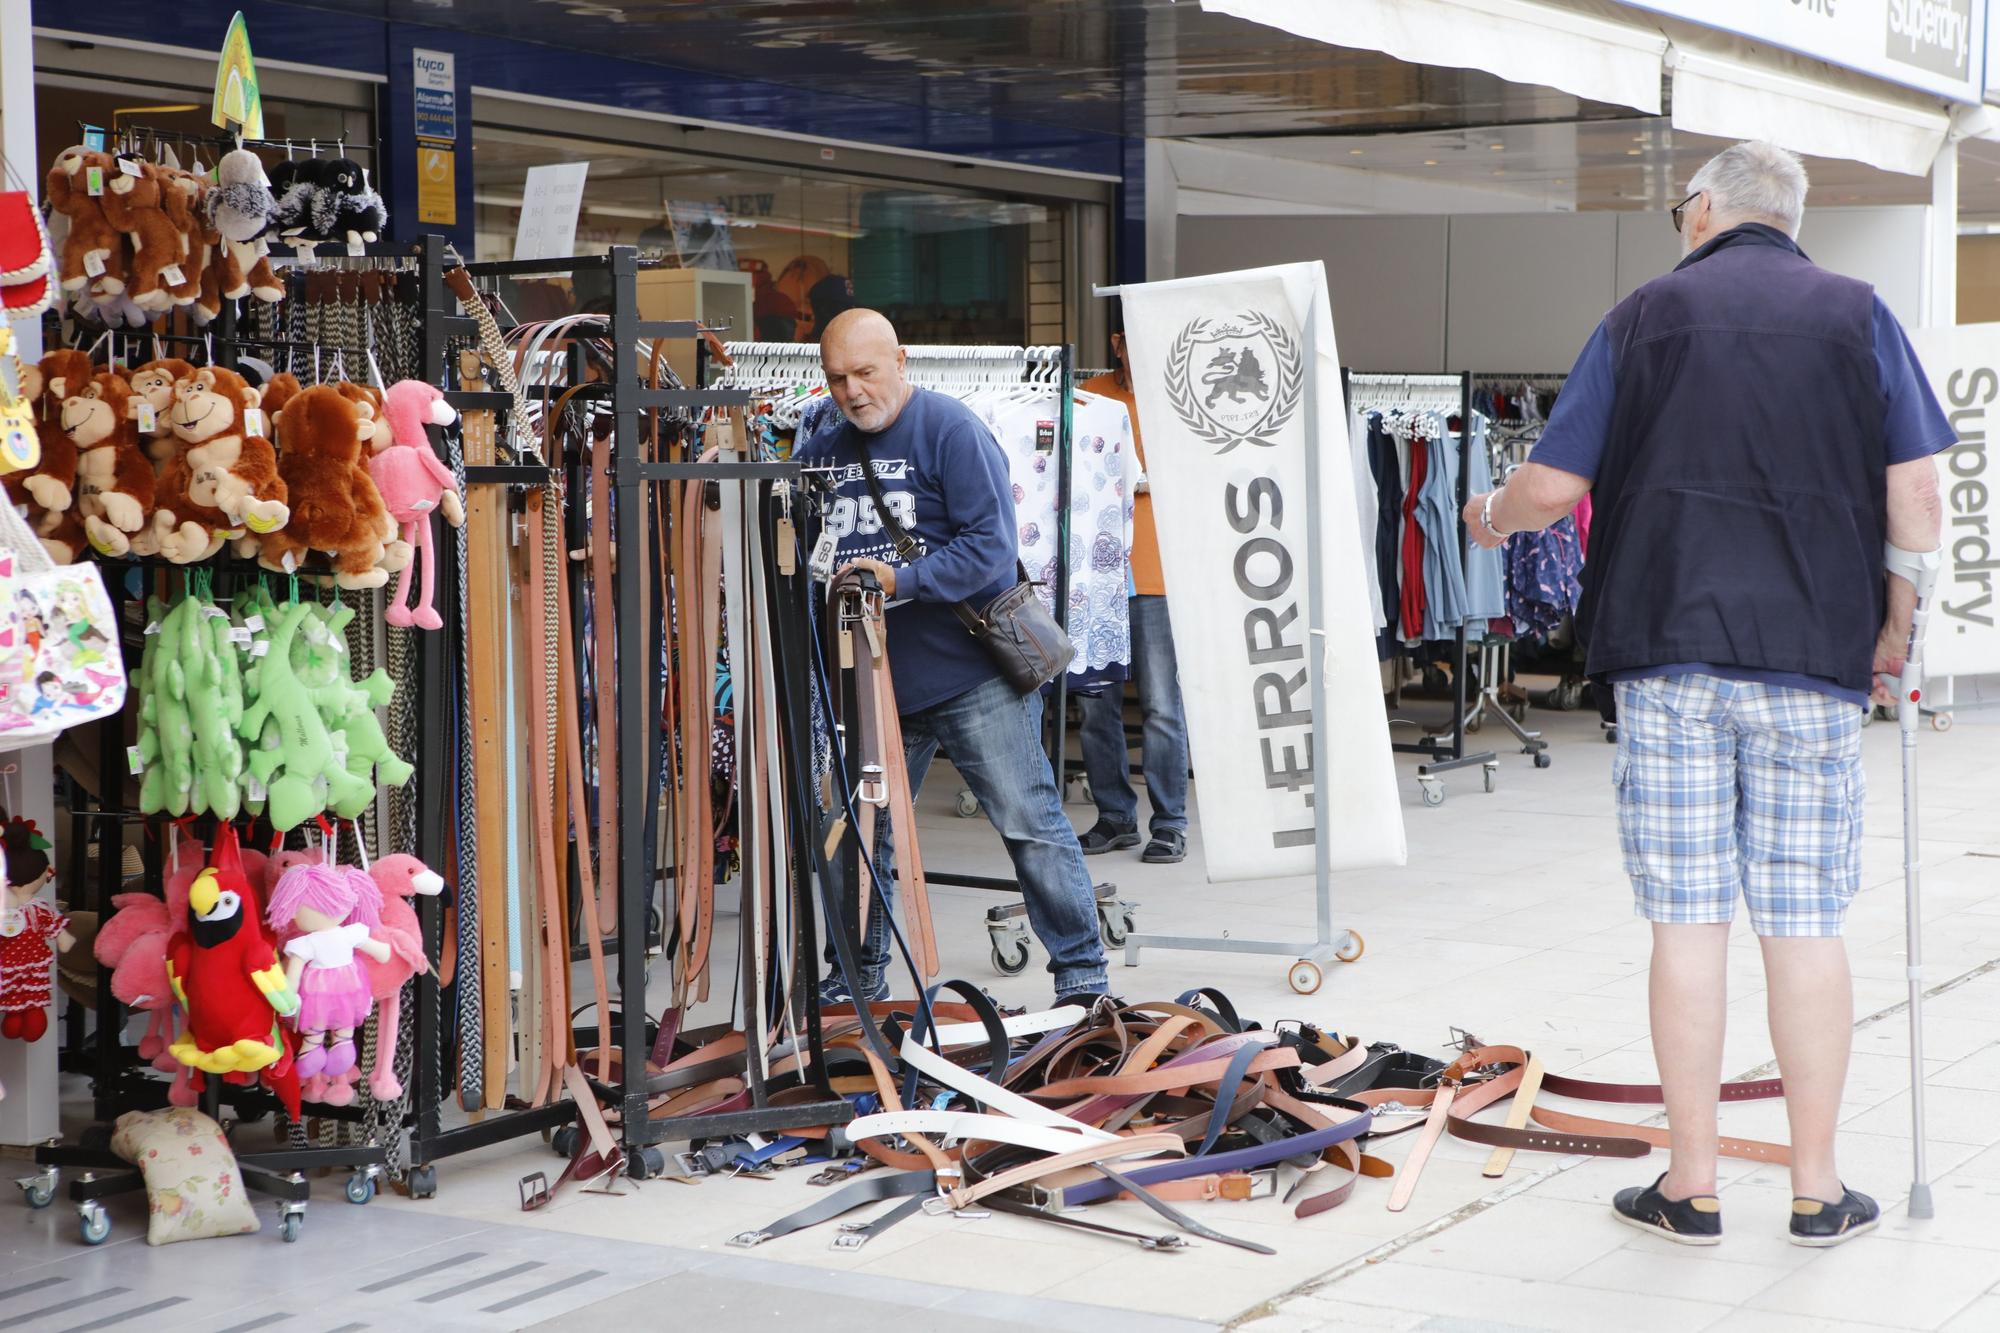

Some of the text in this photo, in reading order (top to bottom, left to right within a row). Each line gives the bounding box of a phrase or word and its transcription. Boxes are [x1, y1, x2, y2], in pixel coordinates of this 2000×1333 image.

[416, 56, 445, 73] tyco
[716, 192, 775, 217] NEW
[1941, 367, 2000, 634] Superdry.
